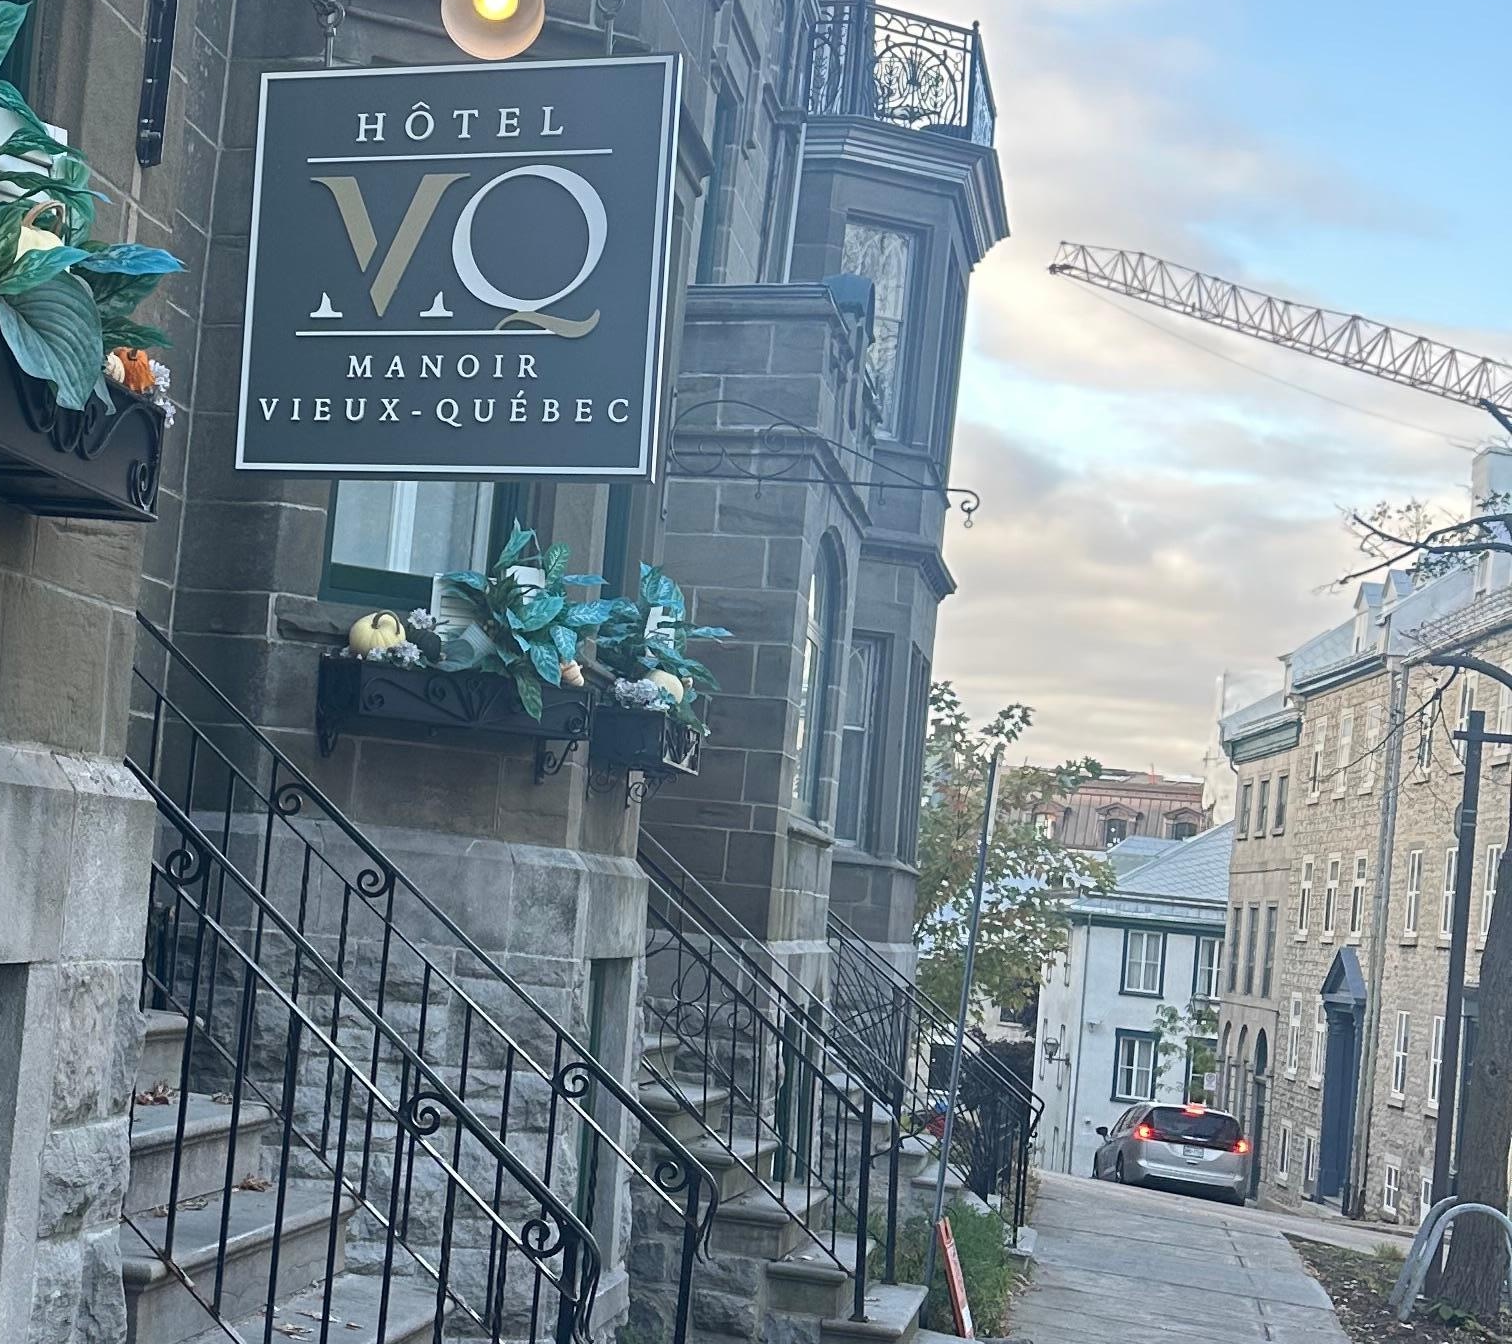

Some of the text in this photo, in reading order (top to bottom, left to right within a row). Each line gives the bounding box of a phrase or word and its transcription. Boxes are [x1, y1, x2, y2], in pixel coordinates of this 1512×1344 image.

[355, 101, 564, 143] HÔTEL
[346, 354, 539, 379] MANOIR
[259, 390, 630, 428] VIEUX-QUÉBEC
